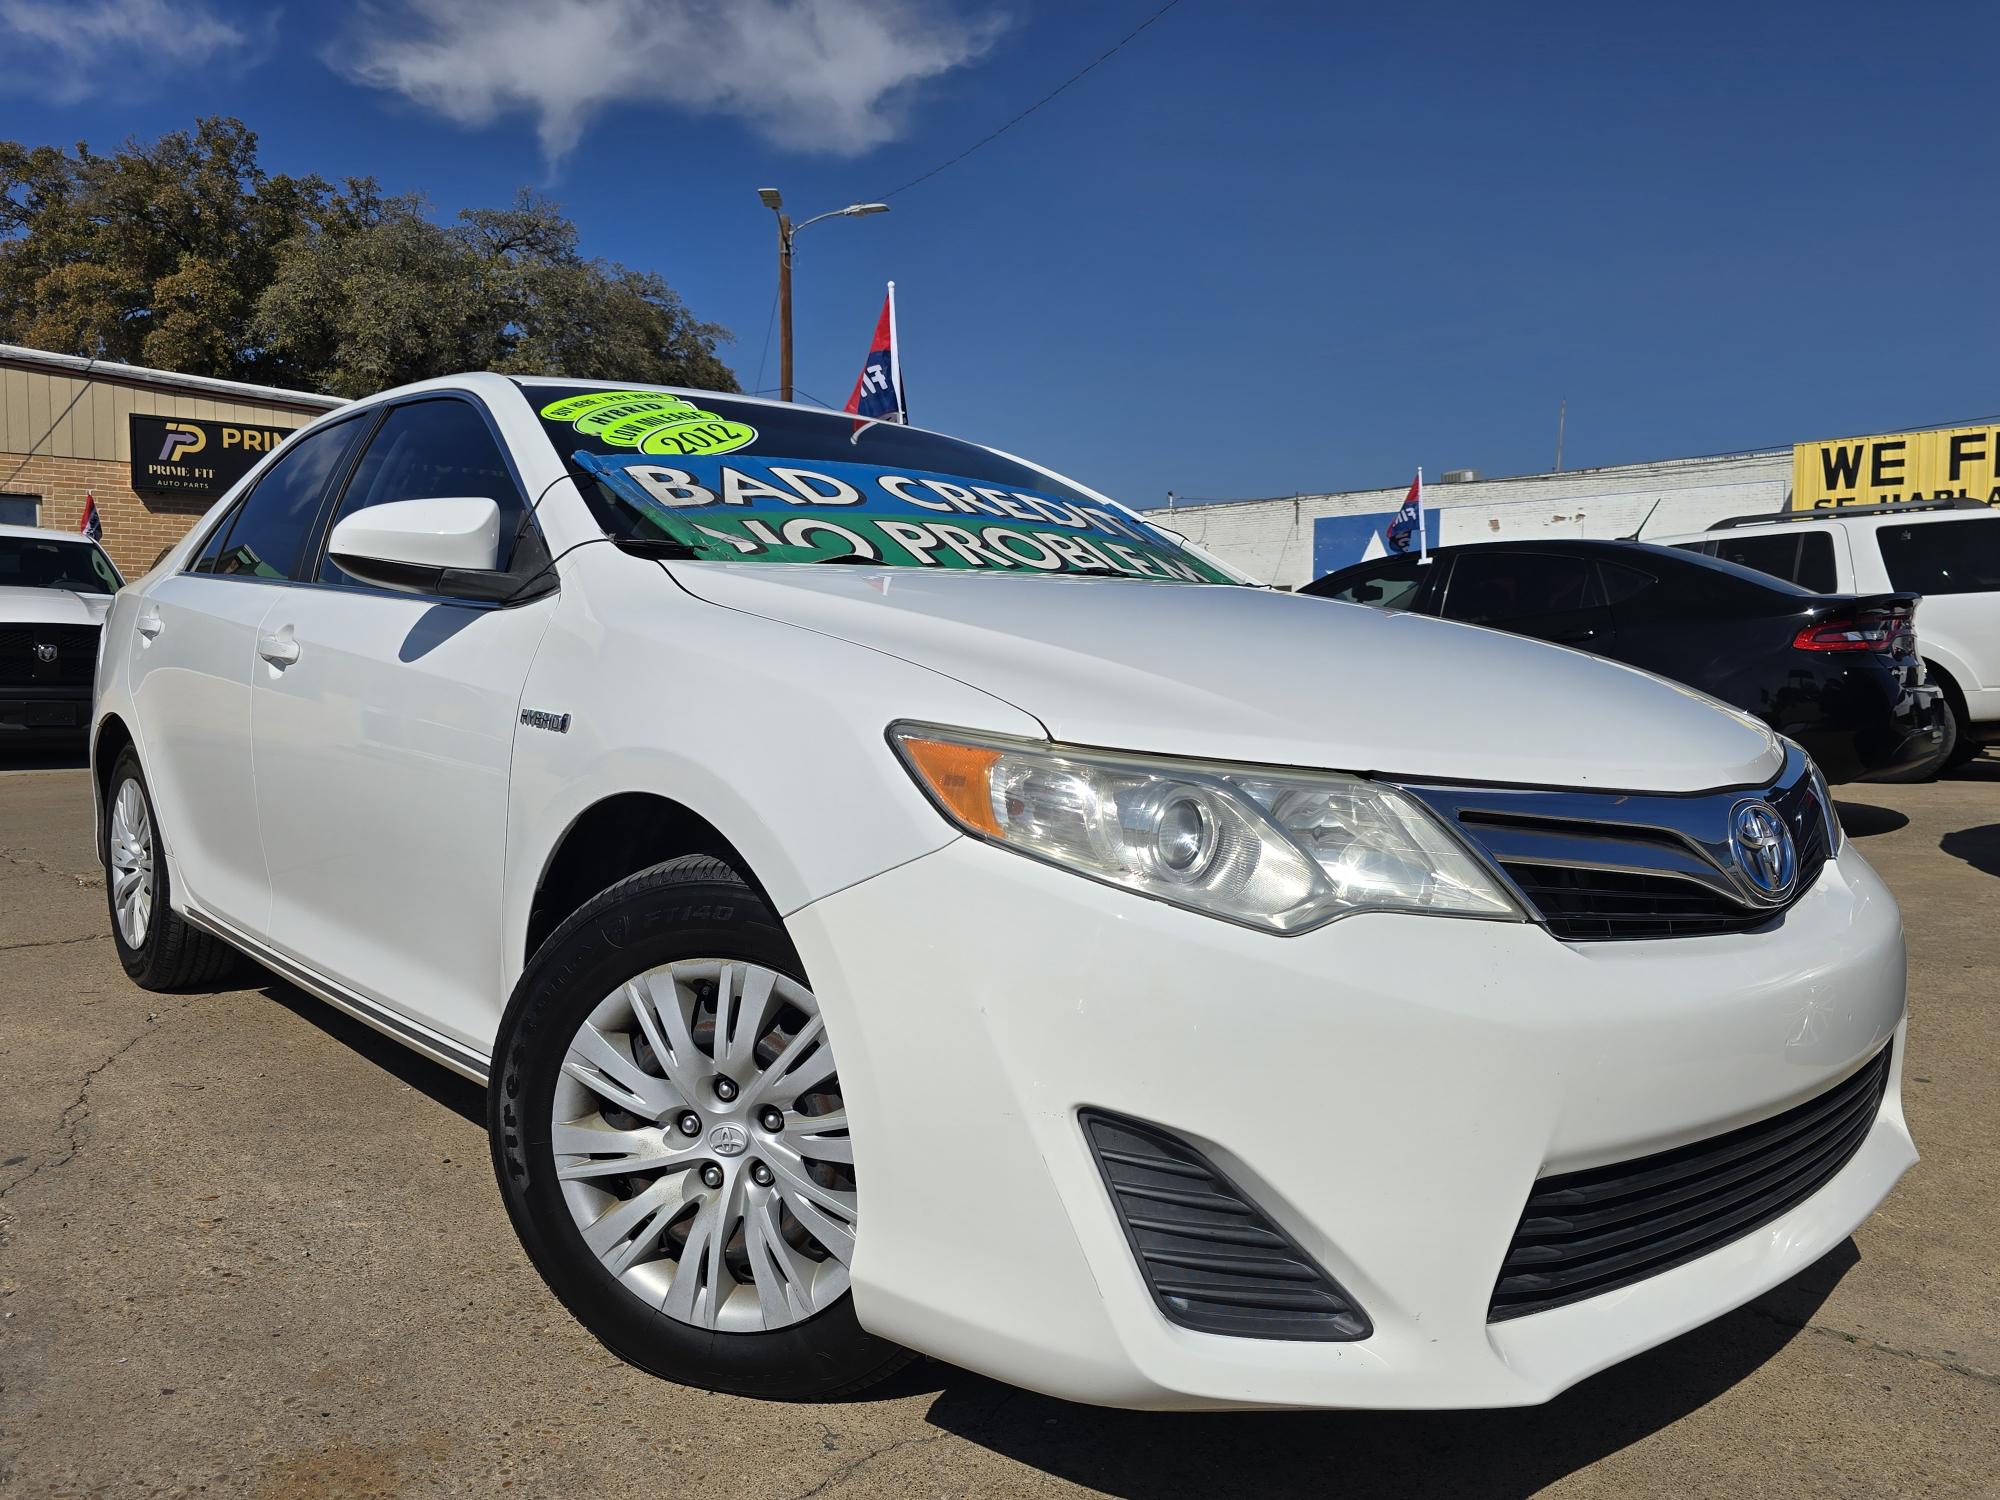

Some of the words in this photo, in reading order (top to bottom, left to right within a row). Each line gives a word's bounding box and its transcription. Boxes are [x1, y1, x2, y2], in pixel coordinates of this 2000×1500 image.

[550, 406, 574, 416] BUY
[573, 398, 596, 408] HERE
[605, 394, 629, 402] PAY
[588, 403, 664, 425] HYBRID
[608, 423, 644, 441] LOW
[635, 411, 706, 428] MILEAGE
[660, 423, 743, 455] 2012
[148, 464, 190, 477] PRIME
[194, 467, 216, 479] FIT
[1821, 440, 1906, 491] WE
[183, 481, 209, 489] PARTS
[622, 464, 867, 508] BAD
[876, 475, 1147, 543] CREDIT
[690, 518, 884, 561] NO
[873, 519, 1212, 584] PROBLEM
[520, 708, 562, 732] HYBRID
